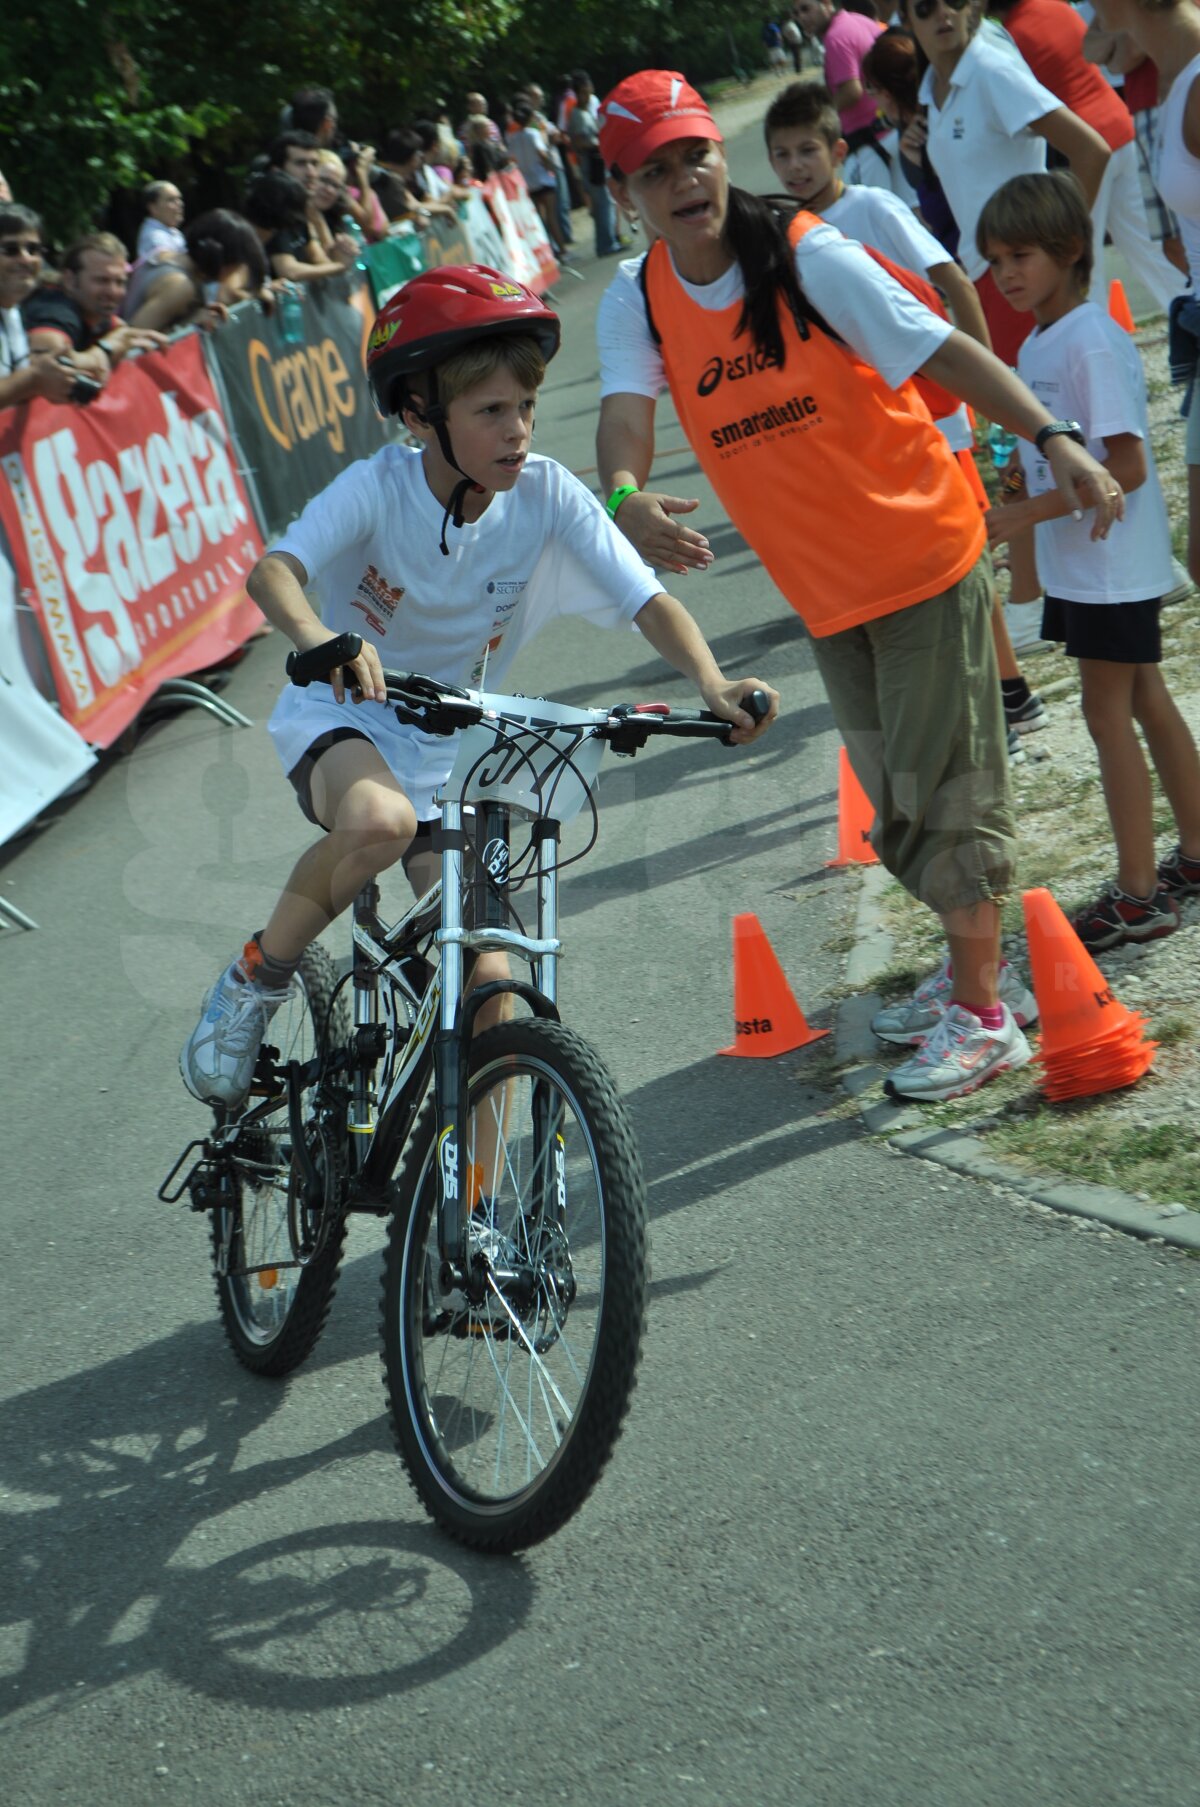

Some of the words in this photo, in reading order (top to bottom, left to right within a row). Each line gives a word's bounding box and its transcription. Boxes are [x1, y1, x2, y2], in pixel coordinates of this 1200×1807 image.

[249, 338, 356, 453] Orange
[478, 711, 584, 796] 577
[444, 1141, 458, 1200] DHS
